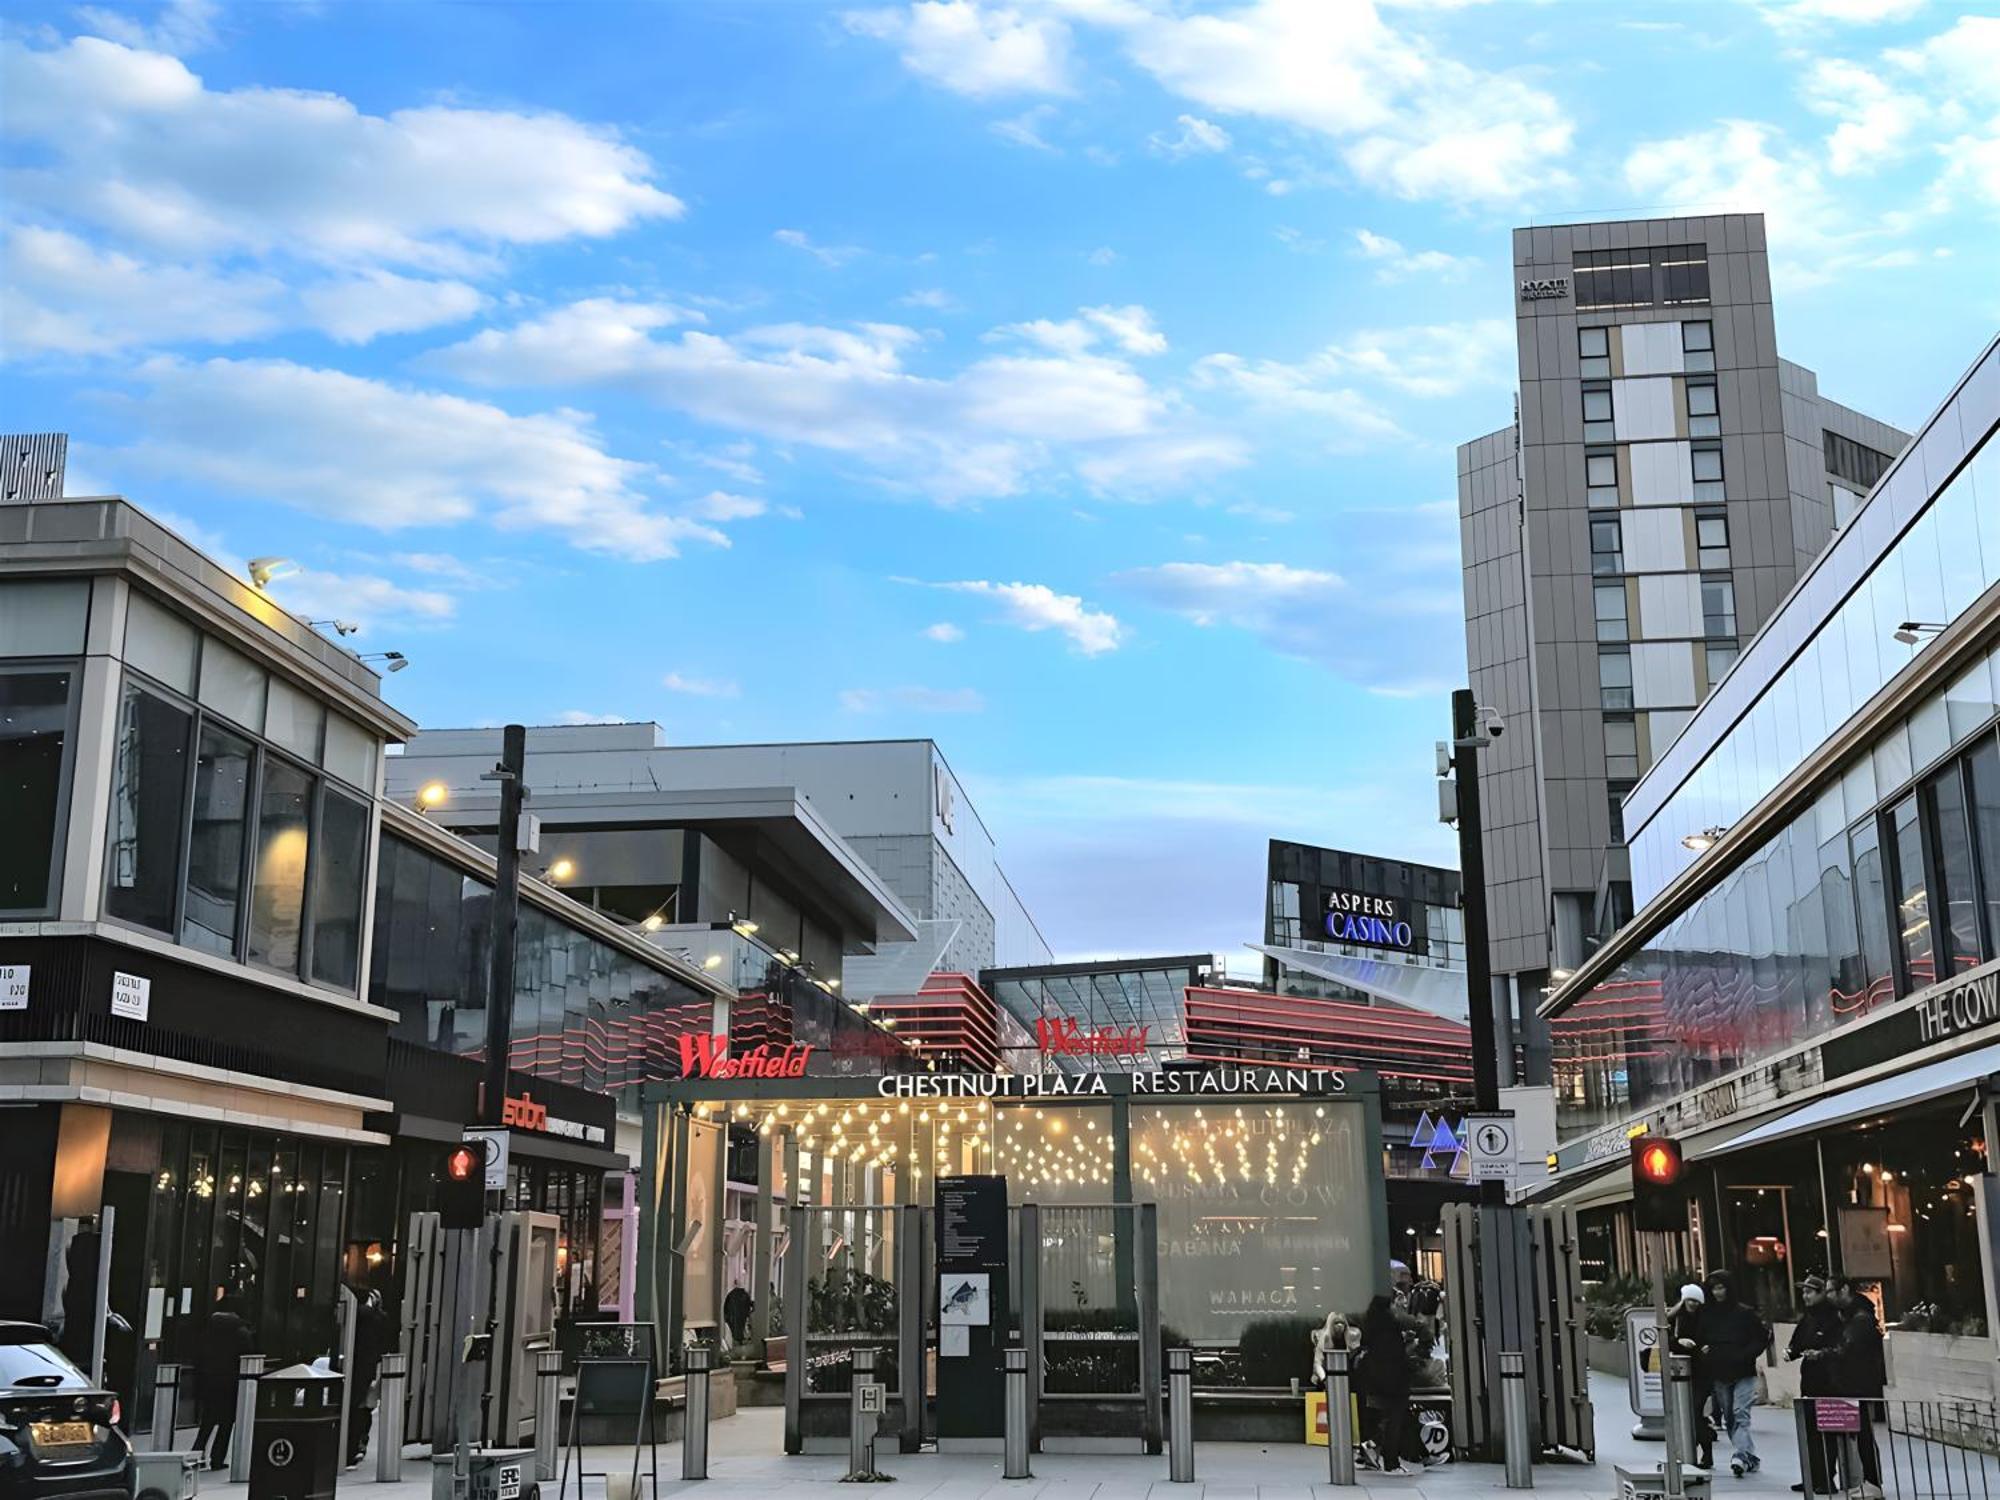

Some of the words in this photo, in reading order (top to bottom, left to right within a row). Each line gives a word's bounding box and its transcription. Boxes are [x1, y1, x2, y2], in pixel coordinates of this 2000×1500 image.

[1329, 892, 1393, 916] ASPERS
[1327, 912, 1412, 947] CASINO
[1915, 994, 1950, 1042] THE
[1953, 973, 1998, 1030] COW
[678, 1032, 815, 1079] Westfield
[878, 1075, 1014, 1097] CHESTNUT
[1023, 1074, 1108, 1096] PLAZA
[1132, 1070, 1345, 1093] RESTAURANTS
